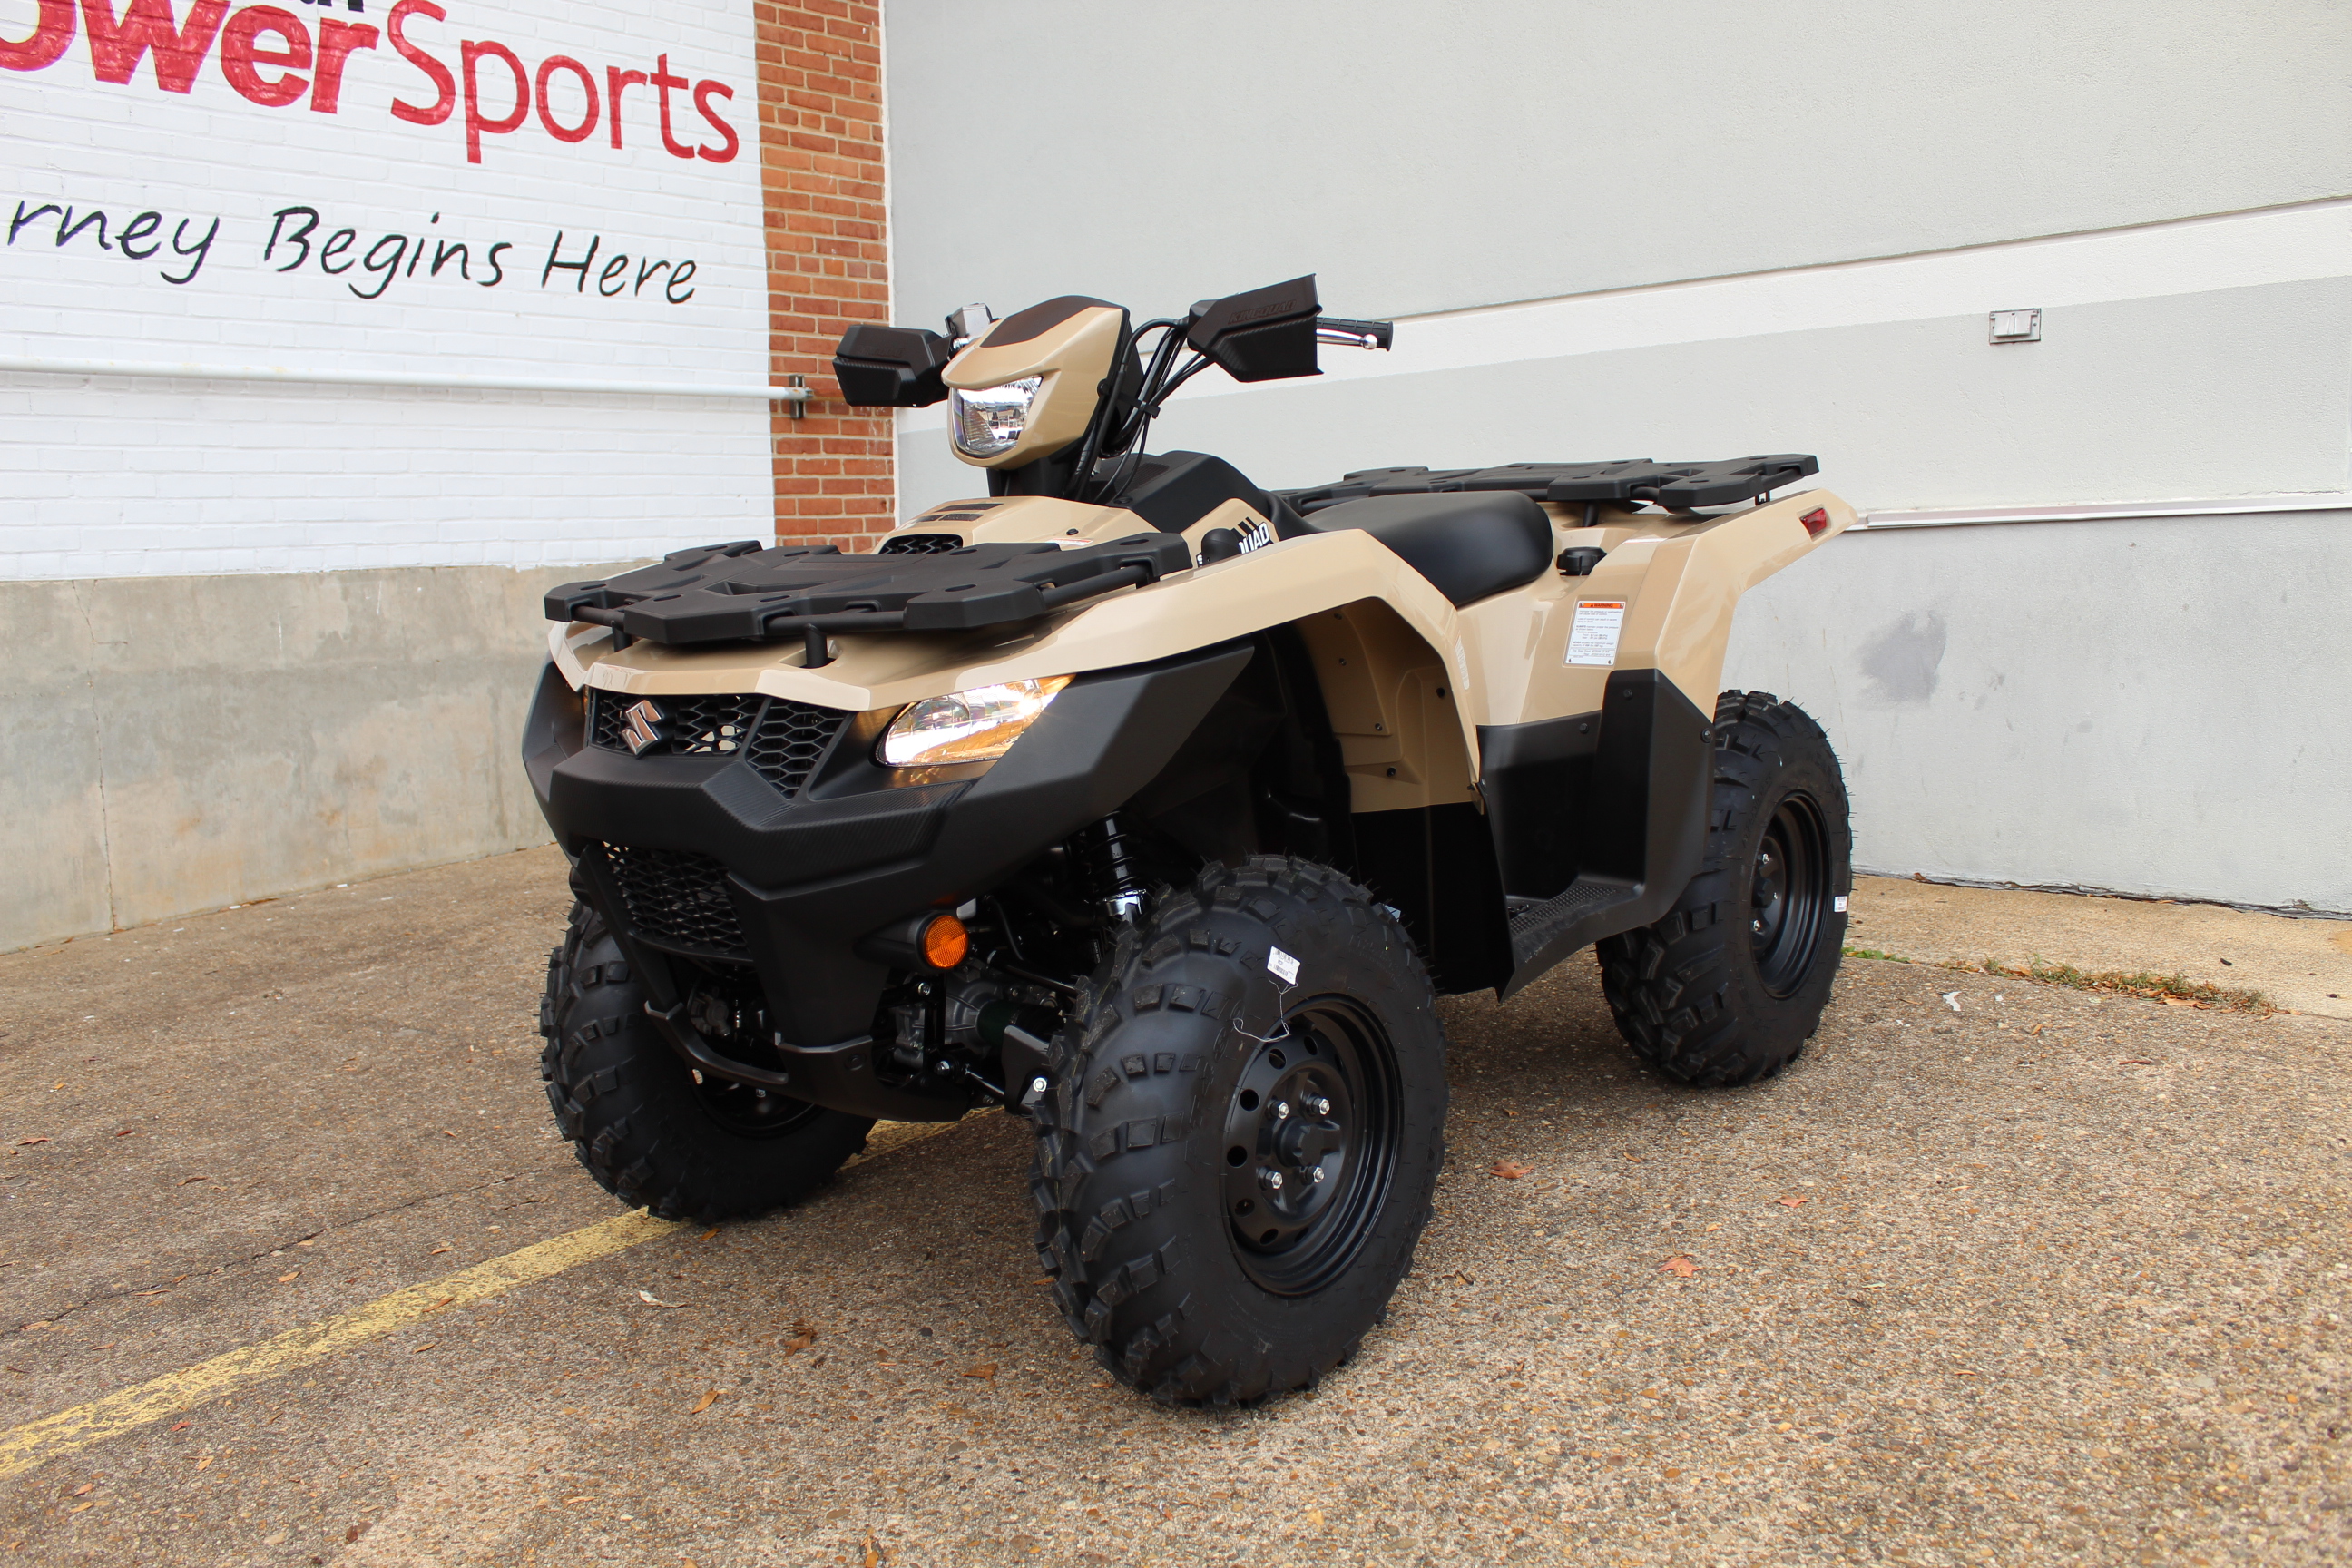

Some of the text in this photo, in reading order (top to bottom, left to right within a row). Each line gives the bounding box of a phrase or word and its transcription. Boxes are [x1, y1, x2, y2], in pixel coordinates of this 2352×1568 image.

[7, 201, 697, 304] rney Begins Here
